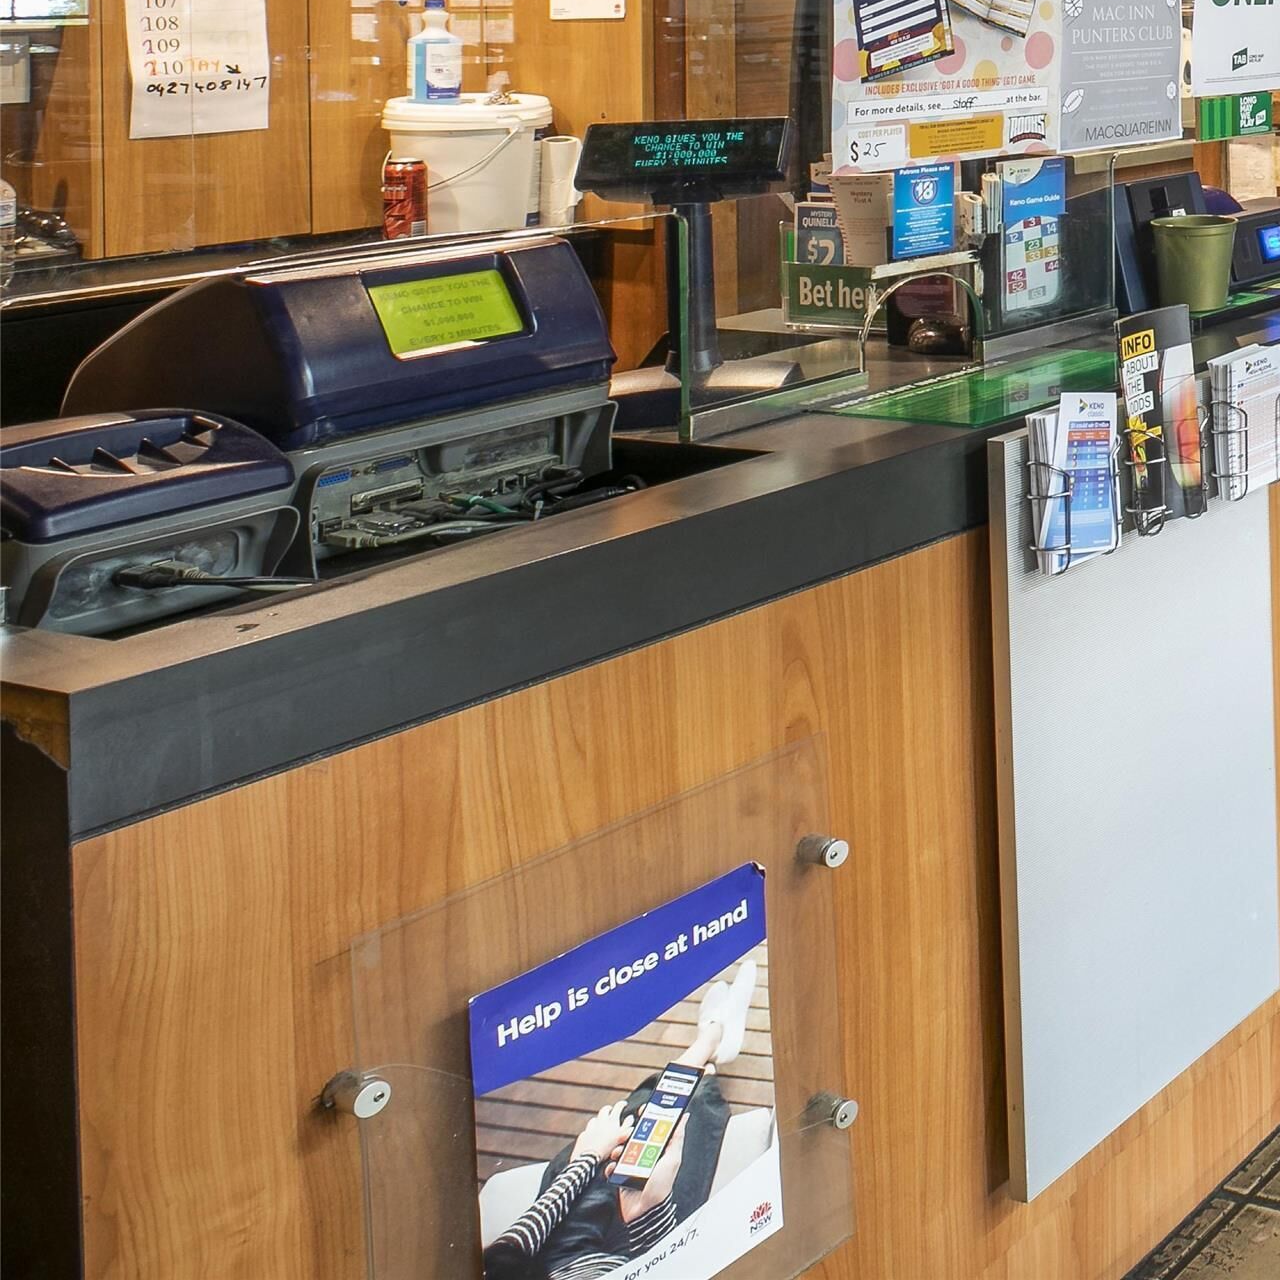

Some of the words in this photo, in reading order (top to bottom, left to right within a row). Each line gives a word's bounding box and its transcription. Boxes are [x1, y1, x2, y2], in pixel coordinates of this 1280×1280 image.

[1092, 5, 1126, 22] MAC
[1129, 4, 1156, 20] INN
[1072, 26, 1137, 45] PUNTERS
[1138, 25, 1174, 41] CLUB
[1233, 53, 1248, 66] TAB
[1006, 95, 1015, 105] at
[1014, 94, 1027, 103] the
[855, 106, 870, 118] For
[871, 107, 894, 116] more
[895, 102, 926, 114] details,
[927, 102, 942, 111] see
[634, 135, 660, 145] KENO
[665, 133, 697, 144] GIVES
[702, 132, 720, 142] YOU
[726, 131, 745, 142] THE
[645, 142, 682, 153] CHANCE
[688, 141, 700, 151] TO
[705, 140, 726, 151] WIN
[1046, 222, 1057, 234] 14
[1010, 270, 1024, 282] 42
[799, 275, 834, 308] Bet
[1012, 281, 1025, 292] 52
[1122, 333, 1152, 357] INFO
[1125, 354, 1156, 376] ABOUT
[1127, 375, 1143, 393] THE
[1089, 401, 1105, 411] KENO
[1129, 396, 1152, 416] ODDS
[496, 999, 564, 1049] Help
[567, 987, 589, 1011] is
[594, 951, 660, 997] close
[663, 933, 688, 962] at
[692, 899, 750, 946] hand
[749, 1213, 773, 1235] NSW
[643, 1251, 669, 1277] you
